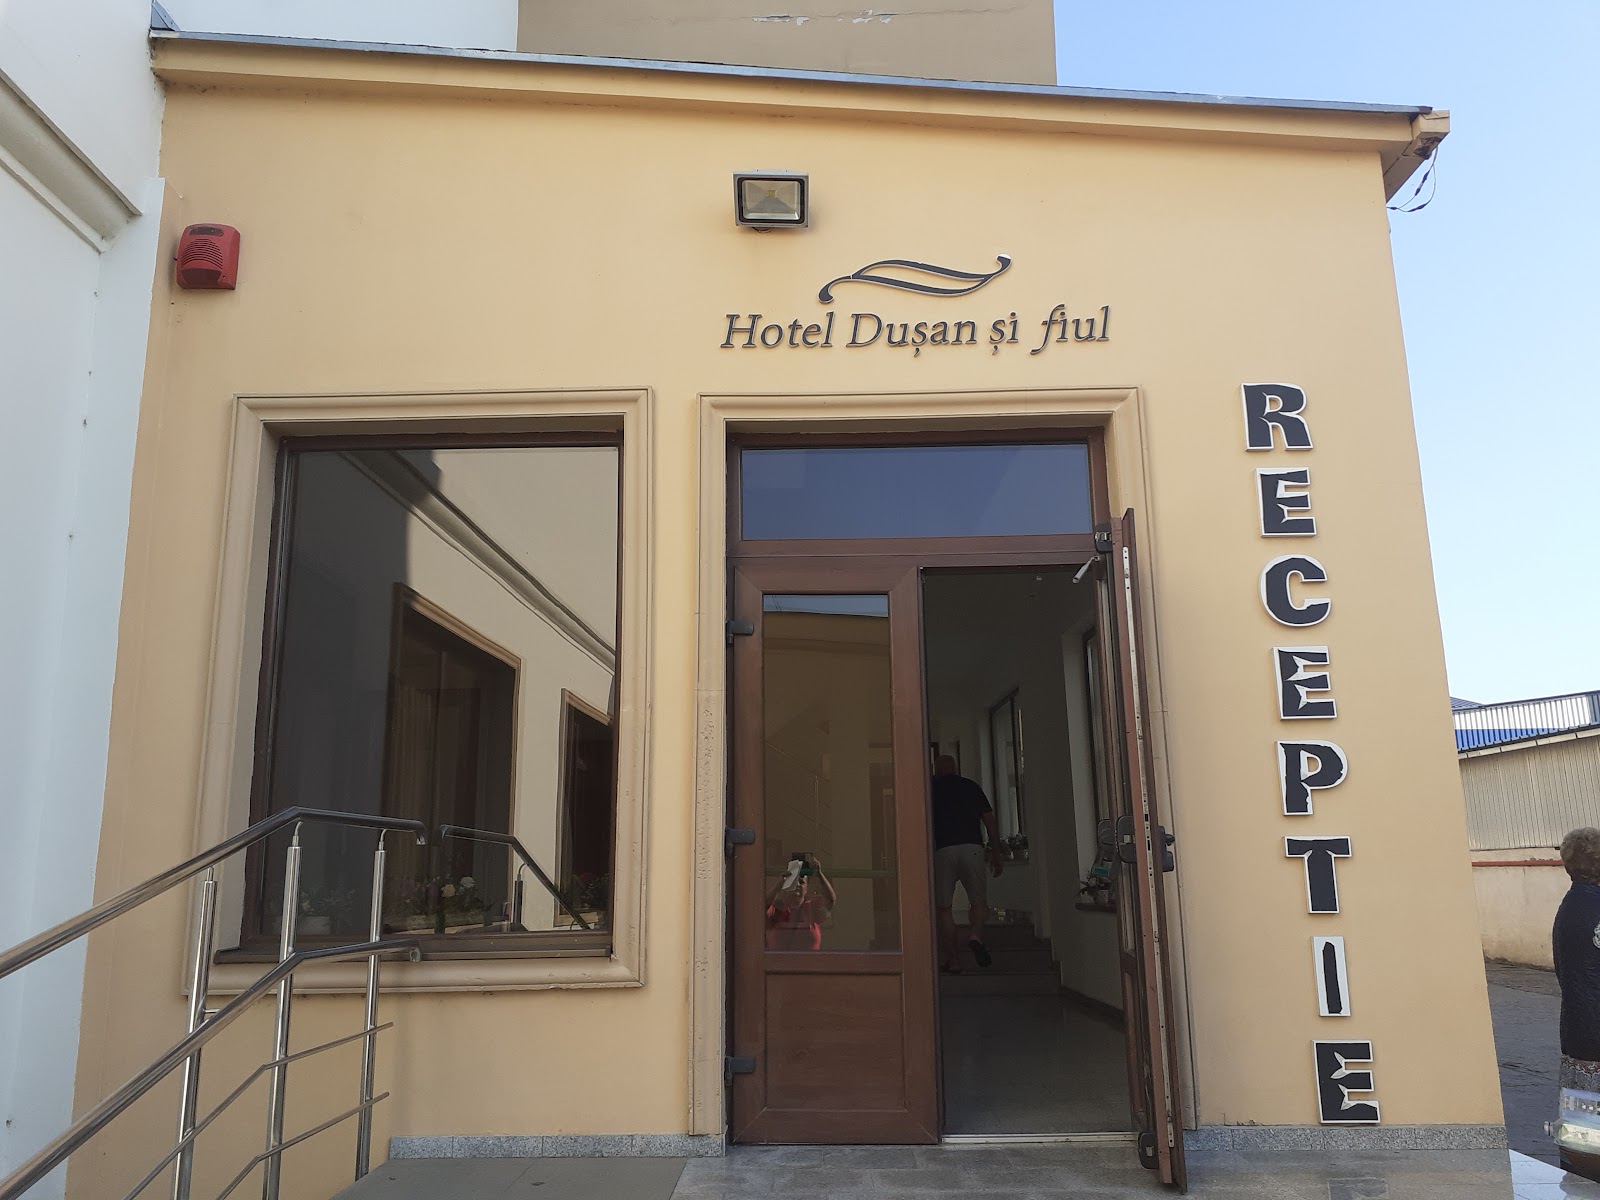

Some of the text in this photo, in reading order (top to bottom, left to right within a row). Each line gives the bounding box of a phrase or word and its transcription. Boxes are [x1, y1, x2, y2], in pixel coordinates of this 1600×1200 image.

[720, 304, 1111, 358] Hotel Dușan și fiul
[1239, 382, 1381, 1125] RECEPTIE
